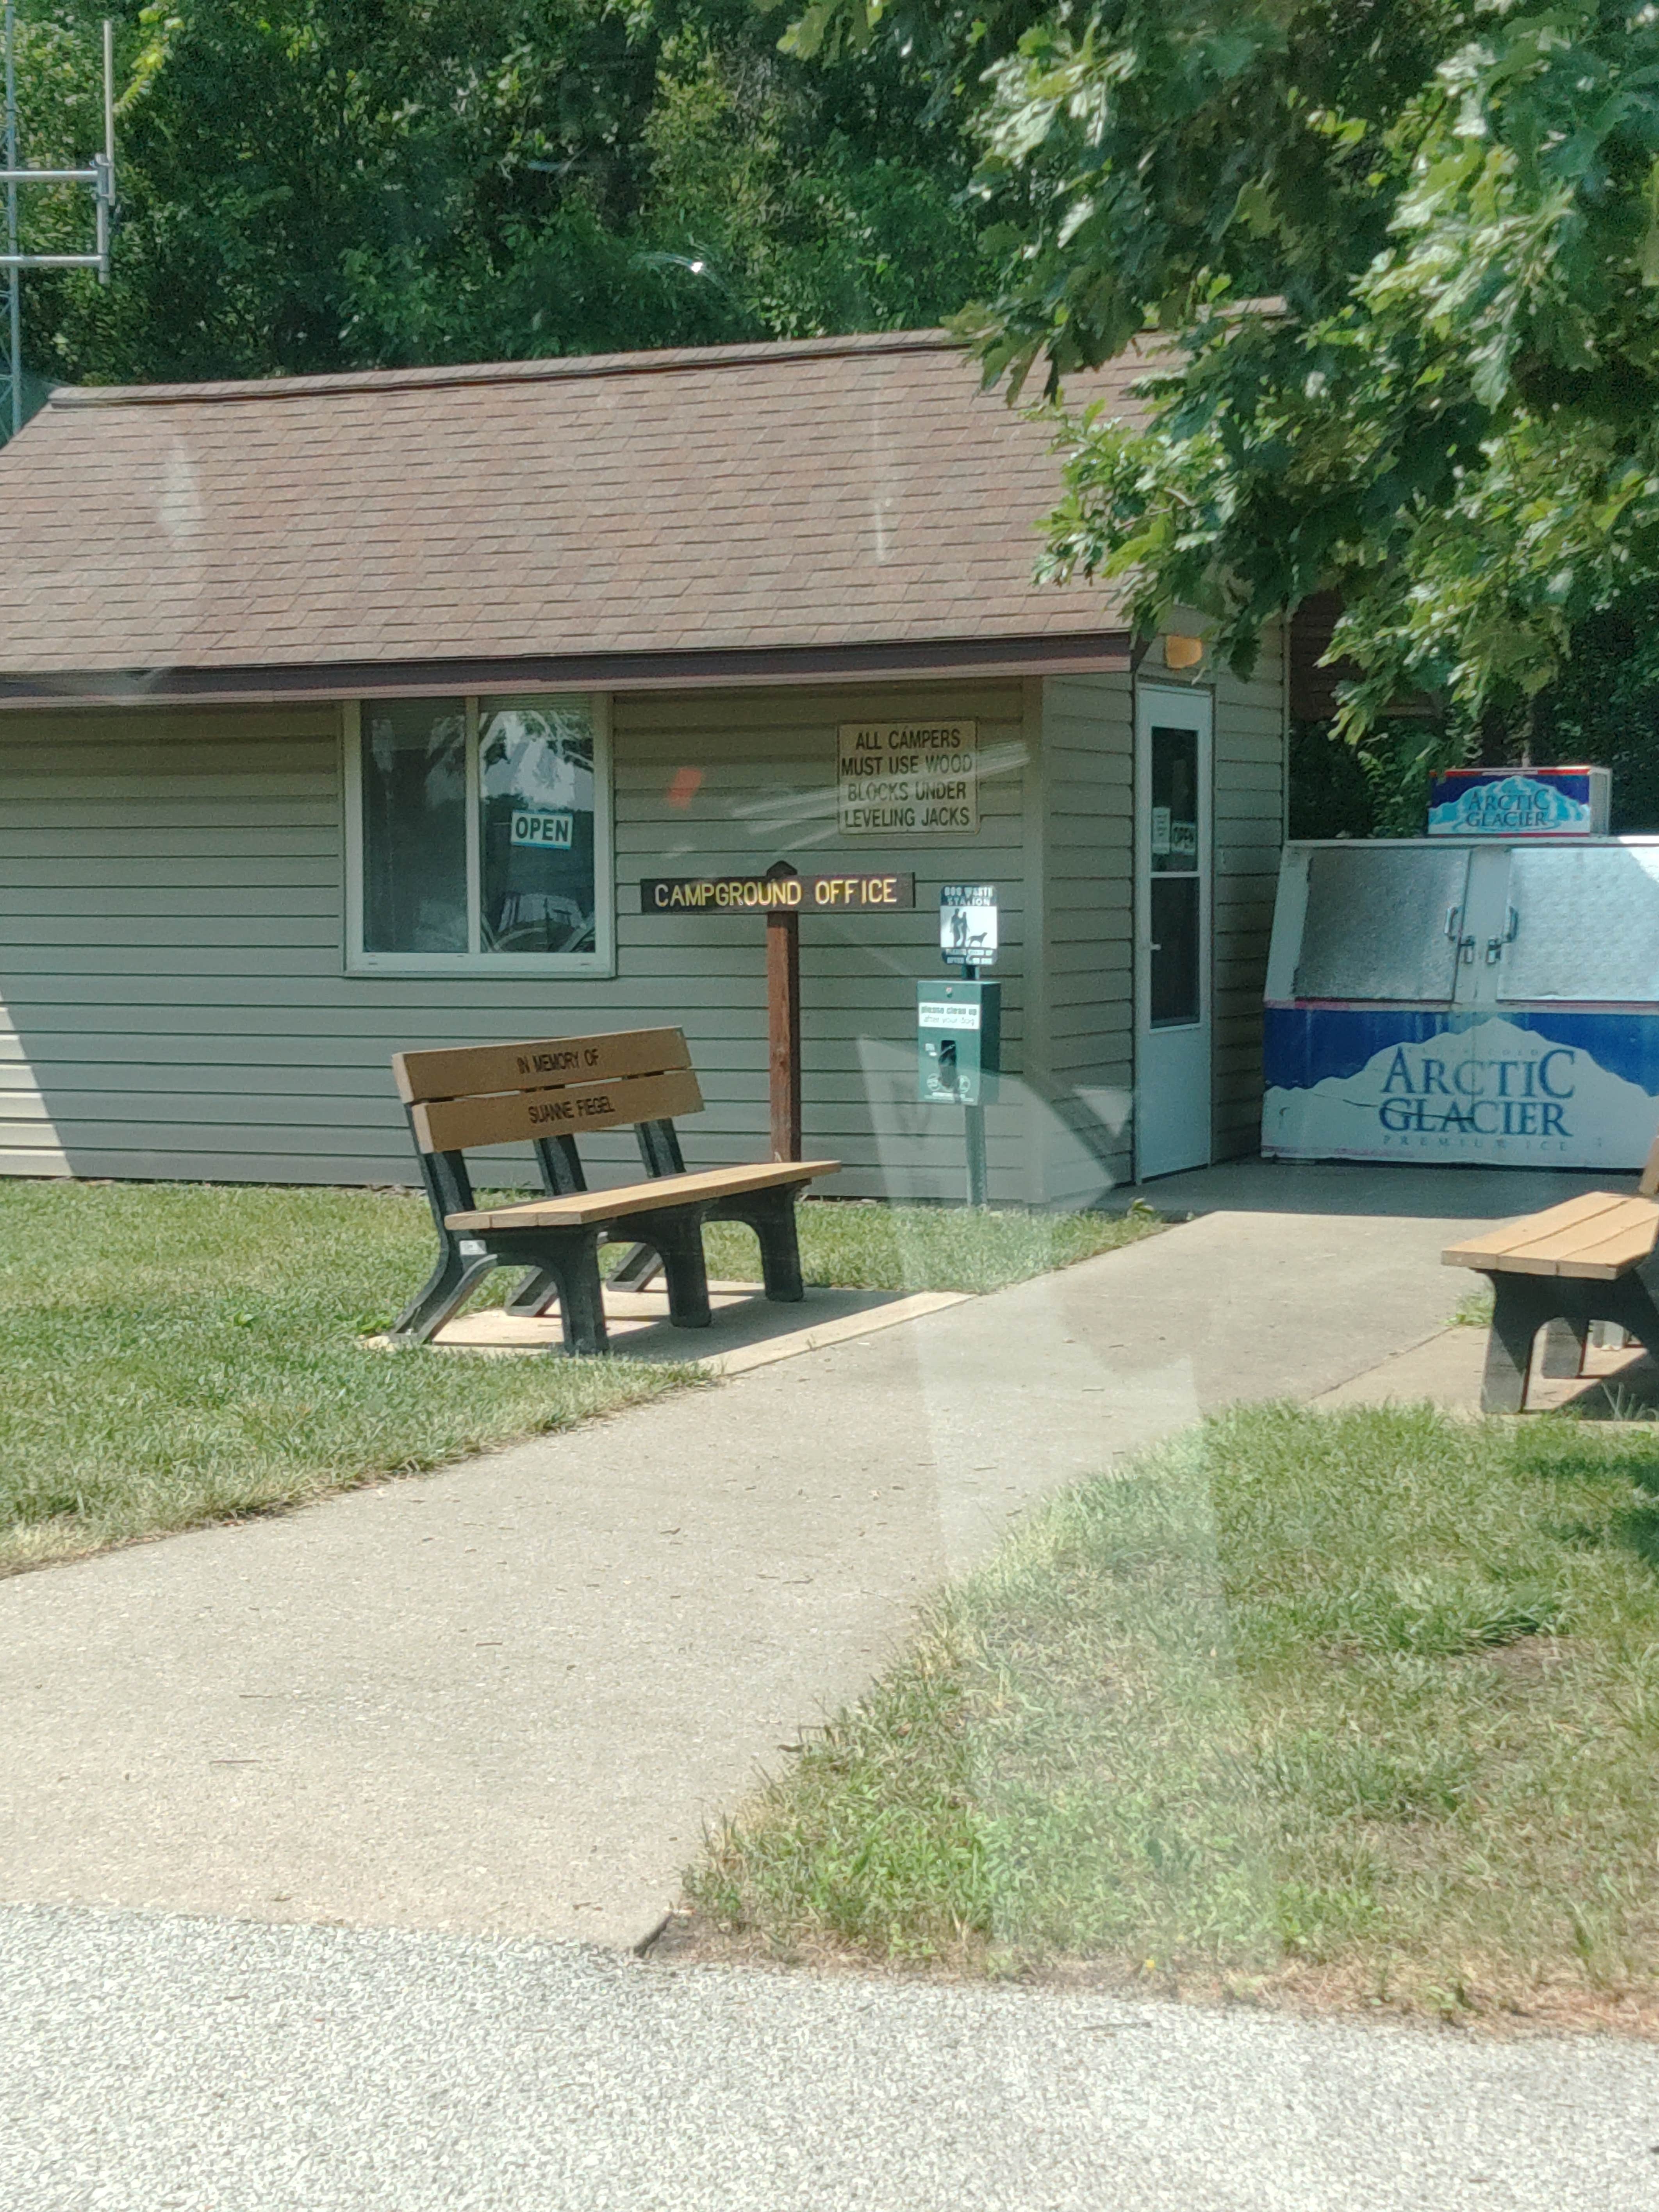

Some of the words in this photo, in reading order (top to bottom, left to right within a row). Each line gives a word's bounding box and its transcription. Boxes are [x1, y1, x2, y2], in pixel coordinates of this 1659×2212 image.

[856, 731, 883, 750] ALL
[888, 729, 961, 749] CAMPERS
[842, 757, 883, 776] MUST
[889, 756, 919, 774] USE
[925, 754, 973, 774] WOOD
[848, 782, 909, 801] BLOCKS
[915, 781, 967, 801] UNDER
[1468, 788, 1550, 811] ARCTIC
[844, 808, 915, 828] LEVELING
[921, 807, 970, 826] JACKS
[1466, 811, 1548, 827] GLACIER
[516, 817, 569, 842] OPEN
[655, 880, 801, 907] CAMPGROUND
[815, 878, 897, 904] OFFICE
[517, 1056, 530, 1074] IN
[532, 1051, 580, 1073] MEMORY
[584, 1048, 599, 1067] OF
[1380, 1046, 1575, 1099] ARCTIC
[1379, 1097, 1573, 1137] GLACIER
